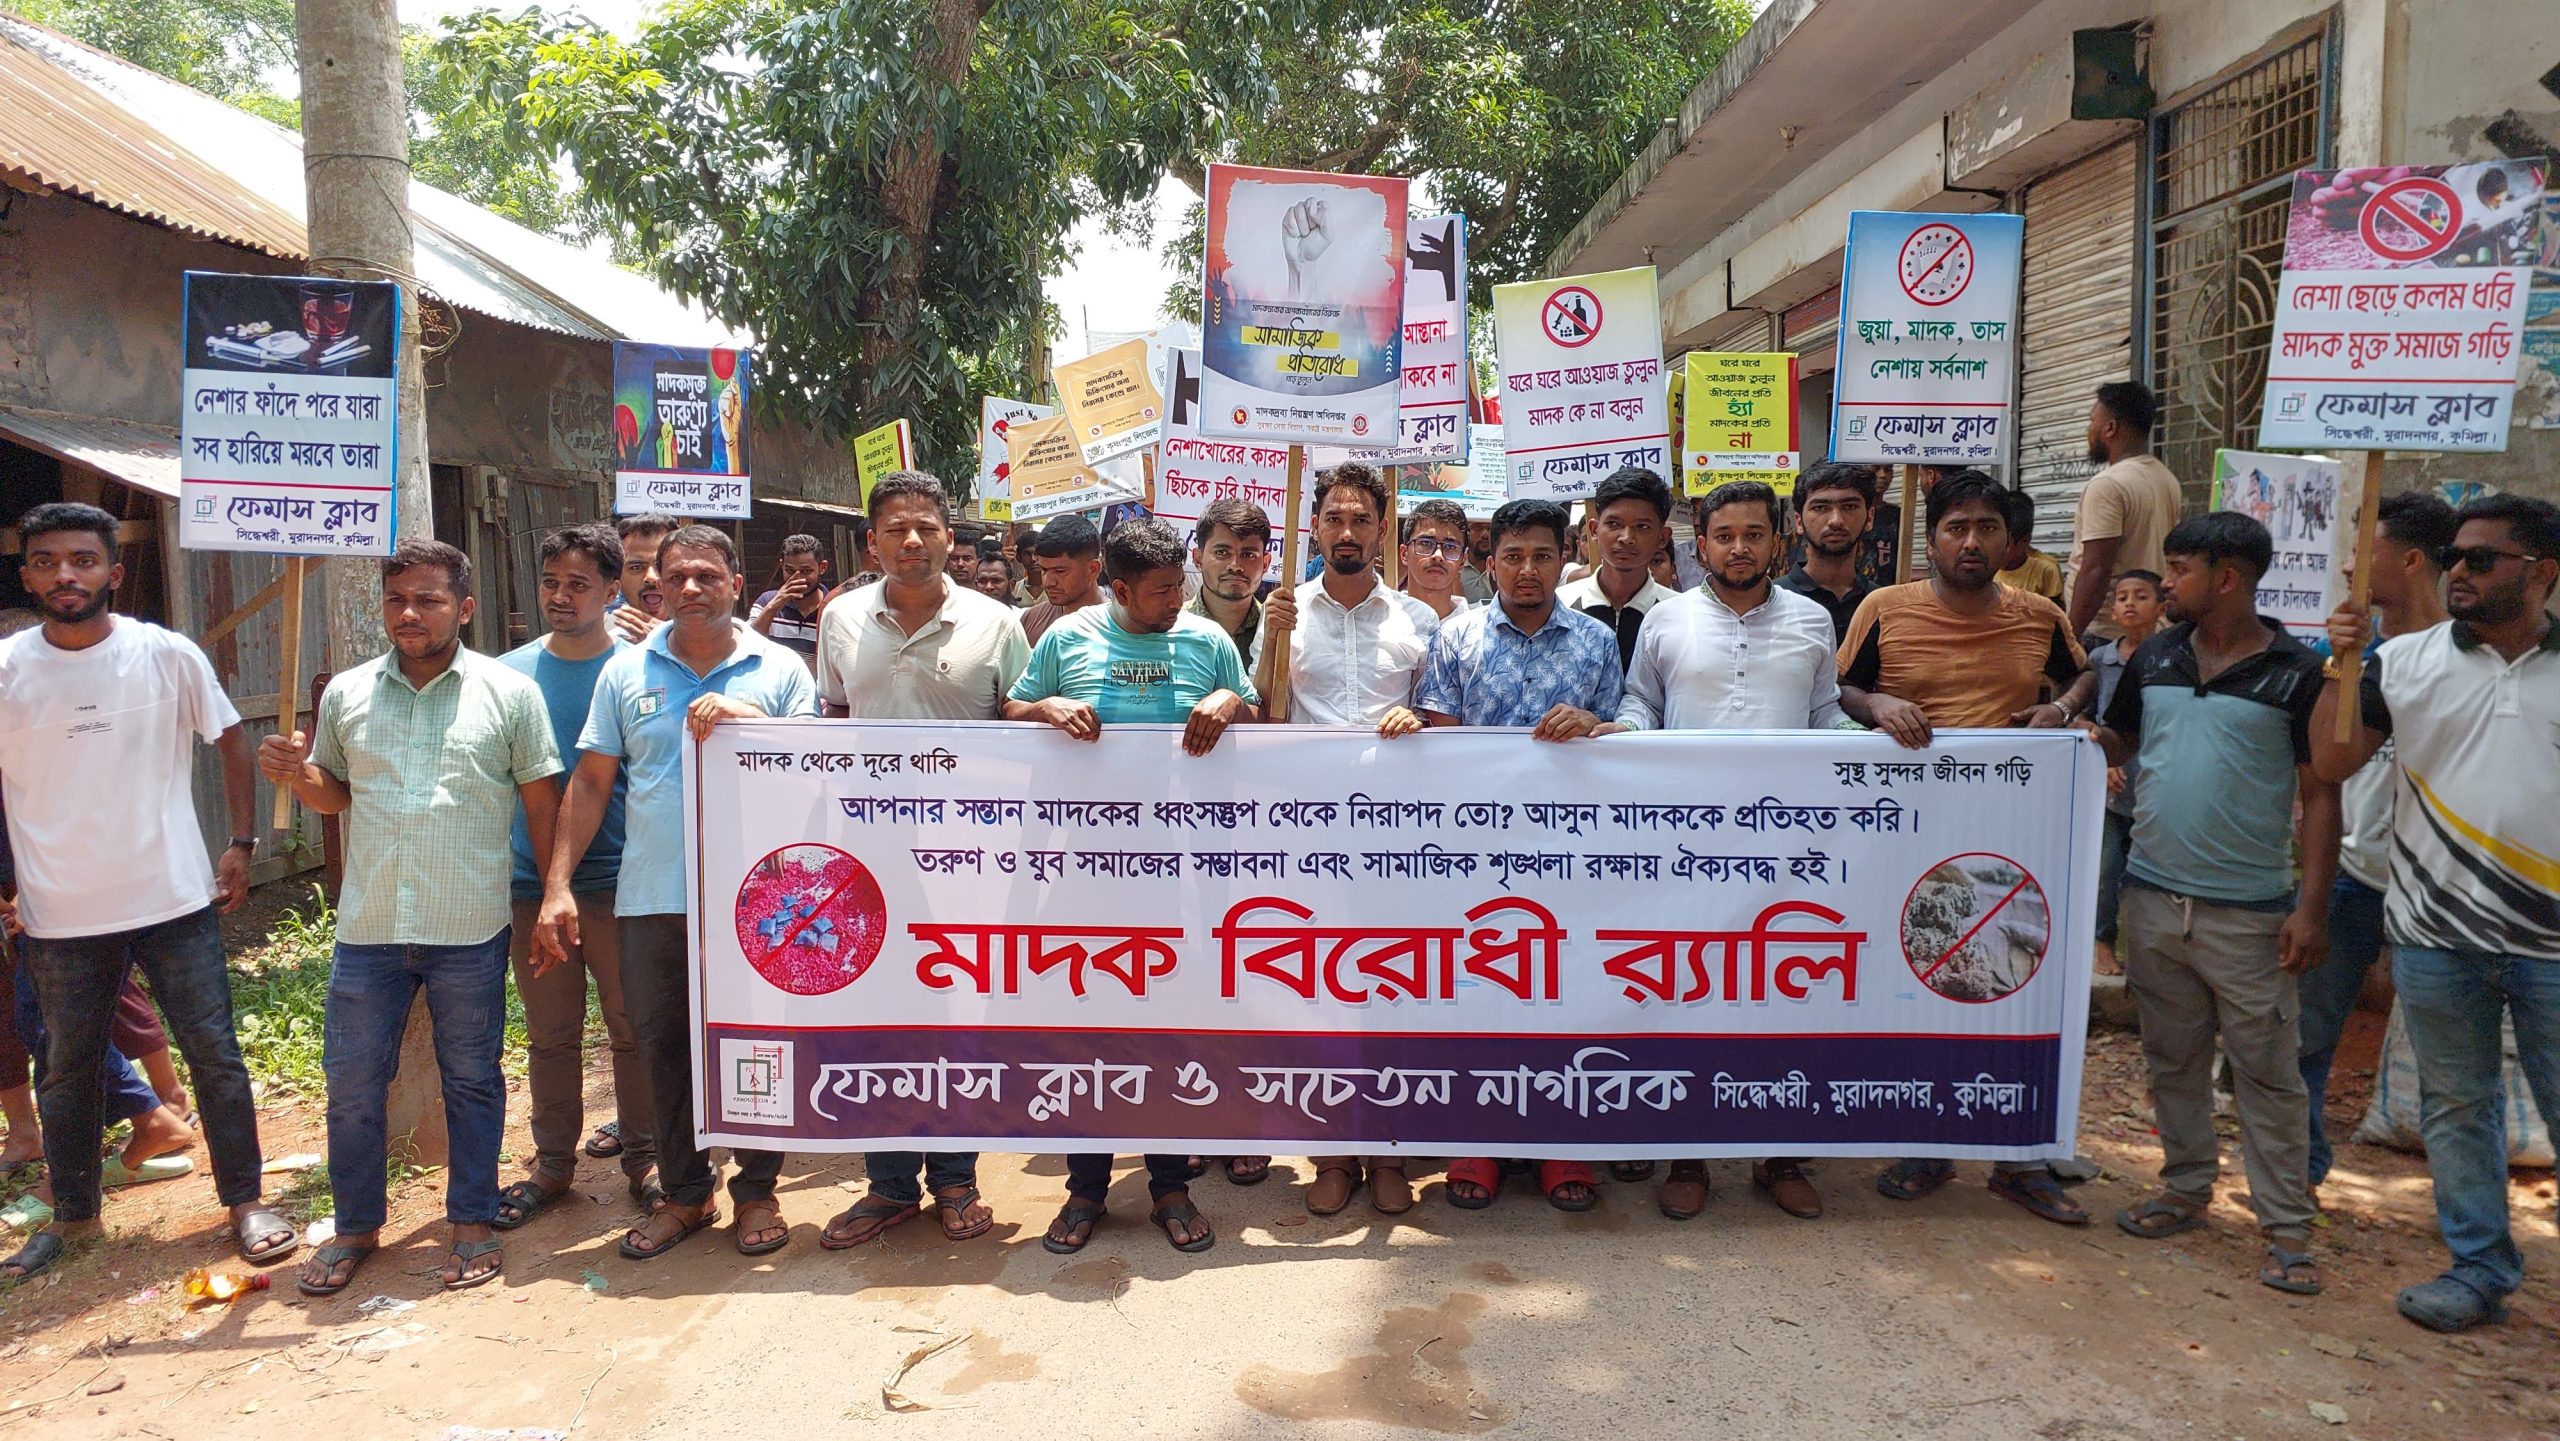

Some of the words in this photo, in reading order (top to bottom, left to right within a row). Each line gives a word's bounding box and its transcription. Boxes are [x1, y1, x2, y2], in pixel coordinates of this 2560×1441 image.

[2293, 284, 2343, 311] নেশা
[2347, 284, 2399, 315] ছেড়ে
[2403, 283, 2467, 310] কলম
[2472, 272, 2516, 313] ধরি
[1254, 317, 1324, 347] সামাজিক
[1403, 319, 1448, 345] আস্তানা
[1857, 318, 1900, 345] জুয়া,
[1907, 319, 1963, 345] মাদক,
[1970, 320, 2006, 341] তাস
[2282, 332, 2343, 358] মাদক
[2348, 332, 2390, 370] মুক্ত
[2394, 332, 2462, 359] সমাজ
[2467, 321, 2514, 364] গড়ি
[1287, 344, 1345, 381] প্রতিরোধ
[1401, 365, 1437, 390] াকবে
[1440, 361, 1457, 386] না
[1508, 374, 1532, 392] ঘরে
[1536, 371, 1561, 389] ঘরে
[1564, 364, 1619, 386] আওয়াজ
[1622, 359, 1658, 385] তুলুন
[1720, 359, 1738, 367] ঘরে
[1742, 359, 1760, 367] ঘরে
[1871, 358, 1924, 379] নেশায়
[1929, 353, 1988, 380] সর্বনাশ
[656, 371, 707, 400] মাদকমুক্ত
[1706, 374, 1746, 382] আওয়াজ
[1749, 375, 1775, 384] তুলুন
[1709, 388, 1749, 397] জীবনের
[1752, 388, 1771, 397] প্রতি
[195, 386, 248, 415] নেশার
[253, 382, 299, 417] ফাঁদে
[306, 392, 341, 419] পরে
[346, 393, 382, 421] যারা
[657, 398, 707, 428] তারুণ্য
[1005, 409, 1024, 421] Just
[1255, 408, 1288, 418] মাদকদ্রব্য
[1290, 407, 1313, 419] নিয়ন্ত্রণ
[1316, 409, 1346, 420] অধিদপ্তর
[1528, 407, 1564, 426] মাদক
[1569, 405, 1585, 423] কে
[1589, 401, 1604, 419] না
[1609, 398, 1644, 420] বলুন
[1727, 398, 1754, 416] হ্যাঁ
[2316, 392, 2419, 423] ফেমাস
[2426, 392, 2499, 426] ক্লাব
[1411, 414, 1457, 443] ক্লাব
[1710, 419, 1748, 428] মাদকের
[1751, 418, 1771, 428] প্রতি
[1874, 414, 1946, 442] ফেমাস
[1951, 414, 1999, 443] ক্লাব
[192, 436, 221, 464] সব
[226, 431, 284, 466] হারিয়ে
[289, 440, 335, 469] মরবে
[340, 441, 382, 470] তারা
[674, 426, 702, 458] চাই
[1166, 438, 1247, 465] নেশাখোরের
[1728, 432, 1752, 448] না
[1543, 452, 1610, 482] ফেমাস
[646, 480, 702, 498] ফেমাস
[707, 482, 743, 502] ক্লাব
[1165, 469, 1210, 499] ছিঁচকে
[226, 496, 315, 526] ফেমাস
[321, 498, 380, 531] ক্লাব
[1111, 661, 1133, 676] SAN
[736, 750, 794, 772] মাদক
[801, 750, 853, 772] থেকে
[862, 753, 901, 781] দূরে
[909, 747, 958, 773] থাকি
[1833, 761, 1868, 789] সুস্থ
[1874, 761, 1925, 788] সুন্দর
[1932, 755, 1987, 783] জীবন
[1994, 756, 2033, 787] গড়ি
[839, 796, 946, 826] আপনার
[956, 797, 1026, 827] সন্তান
[1033, 799, 1142, 828] মাদকের
[1268, 798, 1339, 829] থেকে
[1347, 793, 1446, 829] নিরাপদ
[1454, 798, 1513, 830] তো?
[1523, 802, 1600, 837] আসুন
[1610, 803, 1726, 832] মাদককে
[1735, 797, 1840, 833] প্রতিহত
[911, 847, 985, 875] তরুণ
[995, 853, 1017, 874] ও
[1026, 849, 1065, 885] যুব
[1076, 851, 1182, 878] সমাজের
[1194, 850, 1288, 880] সম্ভাবনা
[1299, 851, 1354, 881] এবং
[1361, 843, 1479, 880] সামাজিক
[1489, 851, 1577, 891] শৃঙ্খলা
[1584, 851, 1661, 881] রক্ষায়
[1672, 844, 1778, 885] ঐক্যবদ্ধ
[907, 923, 1185, 998] মাদক
[1212, 895, 1568, 1004] বিরোধী
[809, 1056, 1009, 1122] ফেমাস
[1019, 1058, 1152, 1122] ক্লাব
[1171, 1060, 1219, 1106] ও
[1238, 1064, 1458, 1124] সচেতন
[1469, 1046, 1695, 1118] নাগরিক
